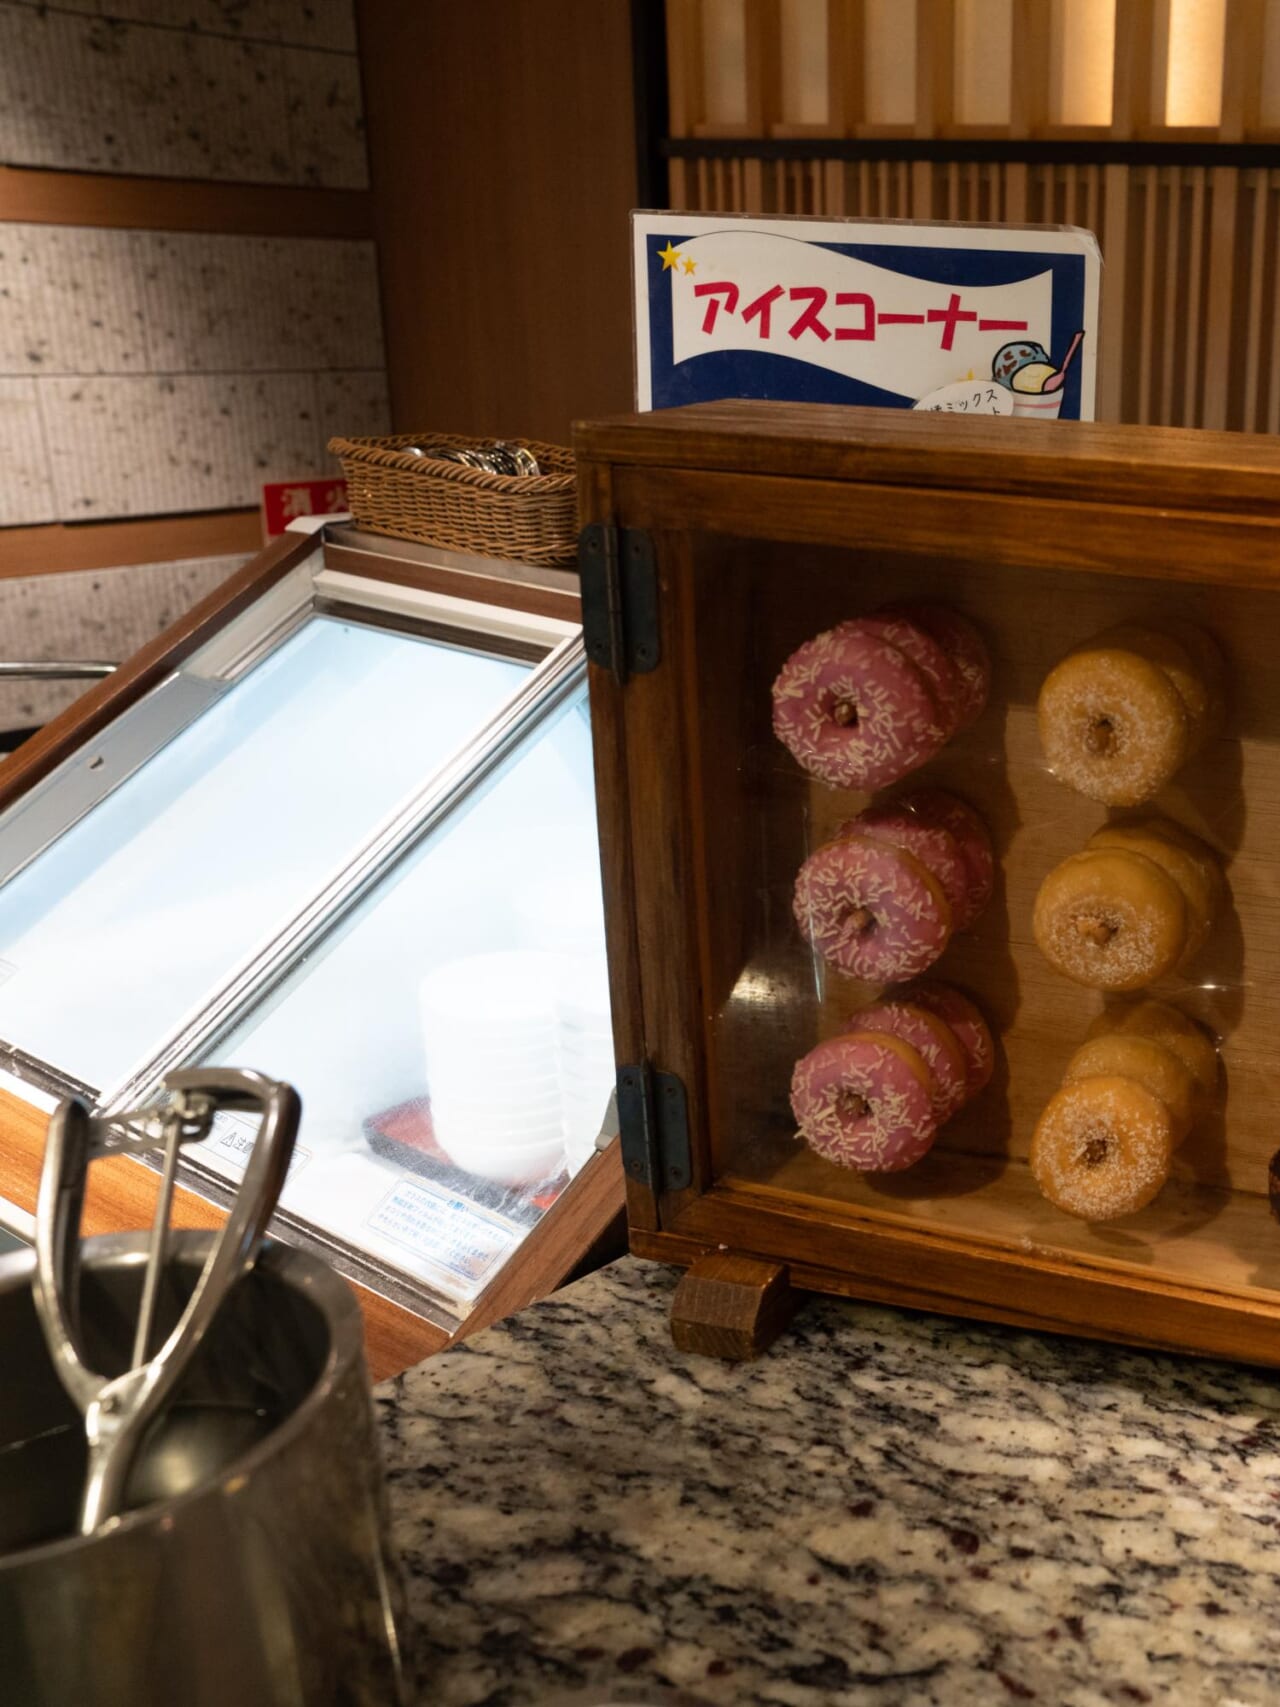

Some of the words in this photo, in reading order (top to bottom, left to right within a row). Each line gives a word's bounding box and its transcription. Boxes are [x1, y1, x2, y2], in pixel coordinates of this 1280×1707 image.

[694, 281, 1028, 351] アイスコーナー
